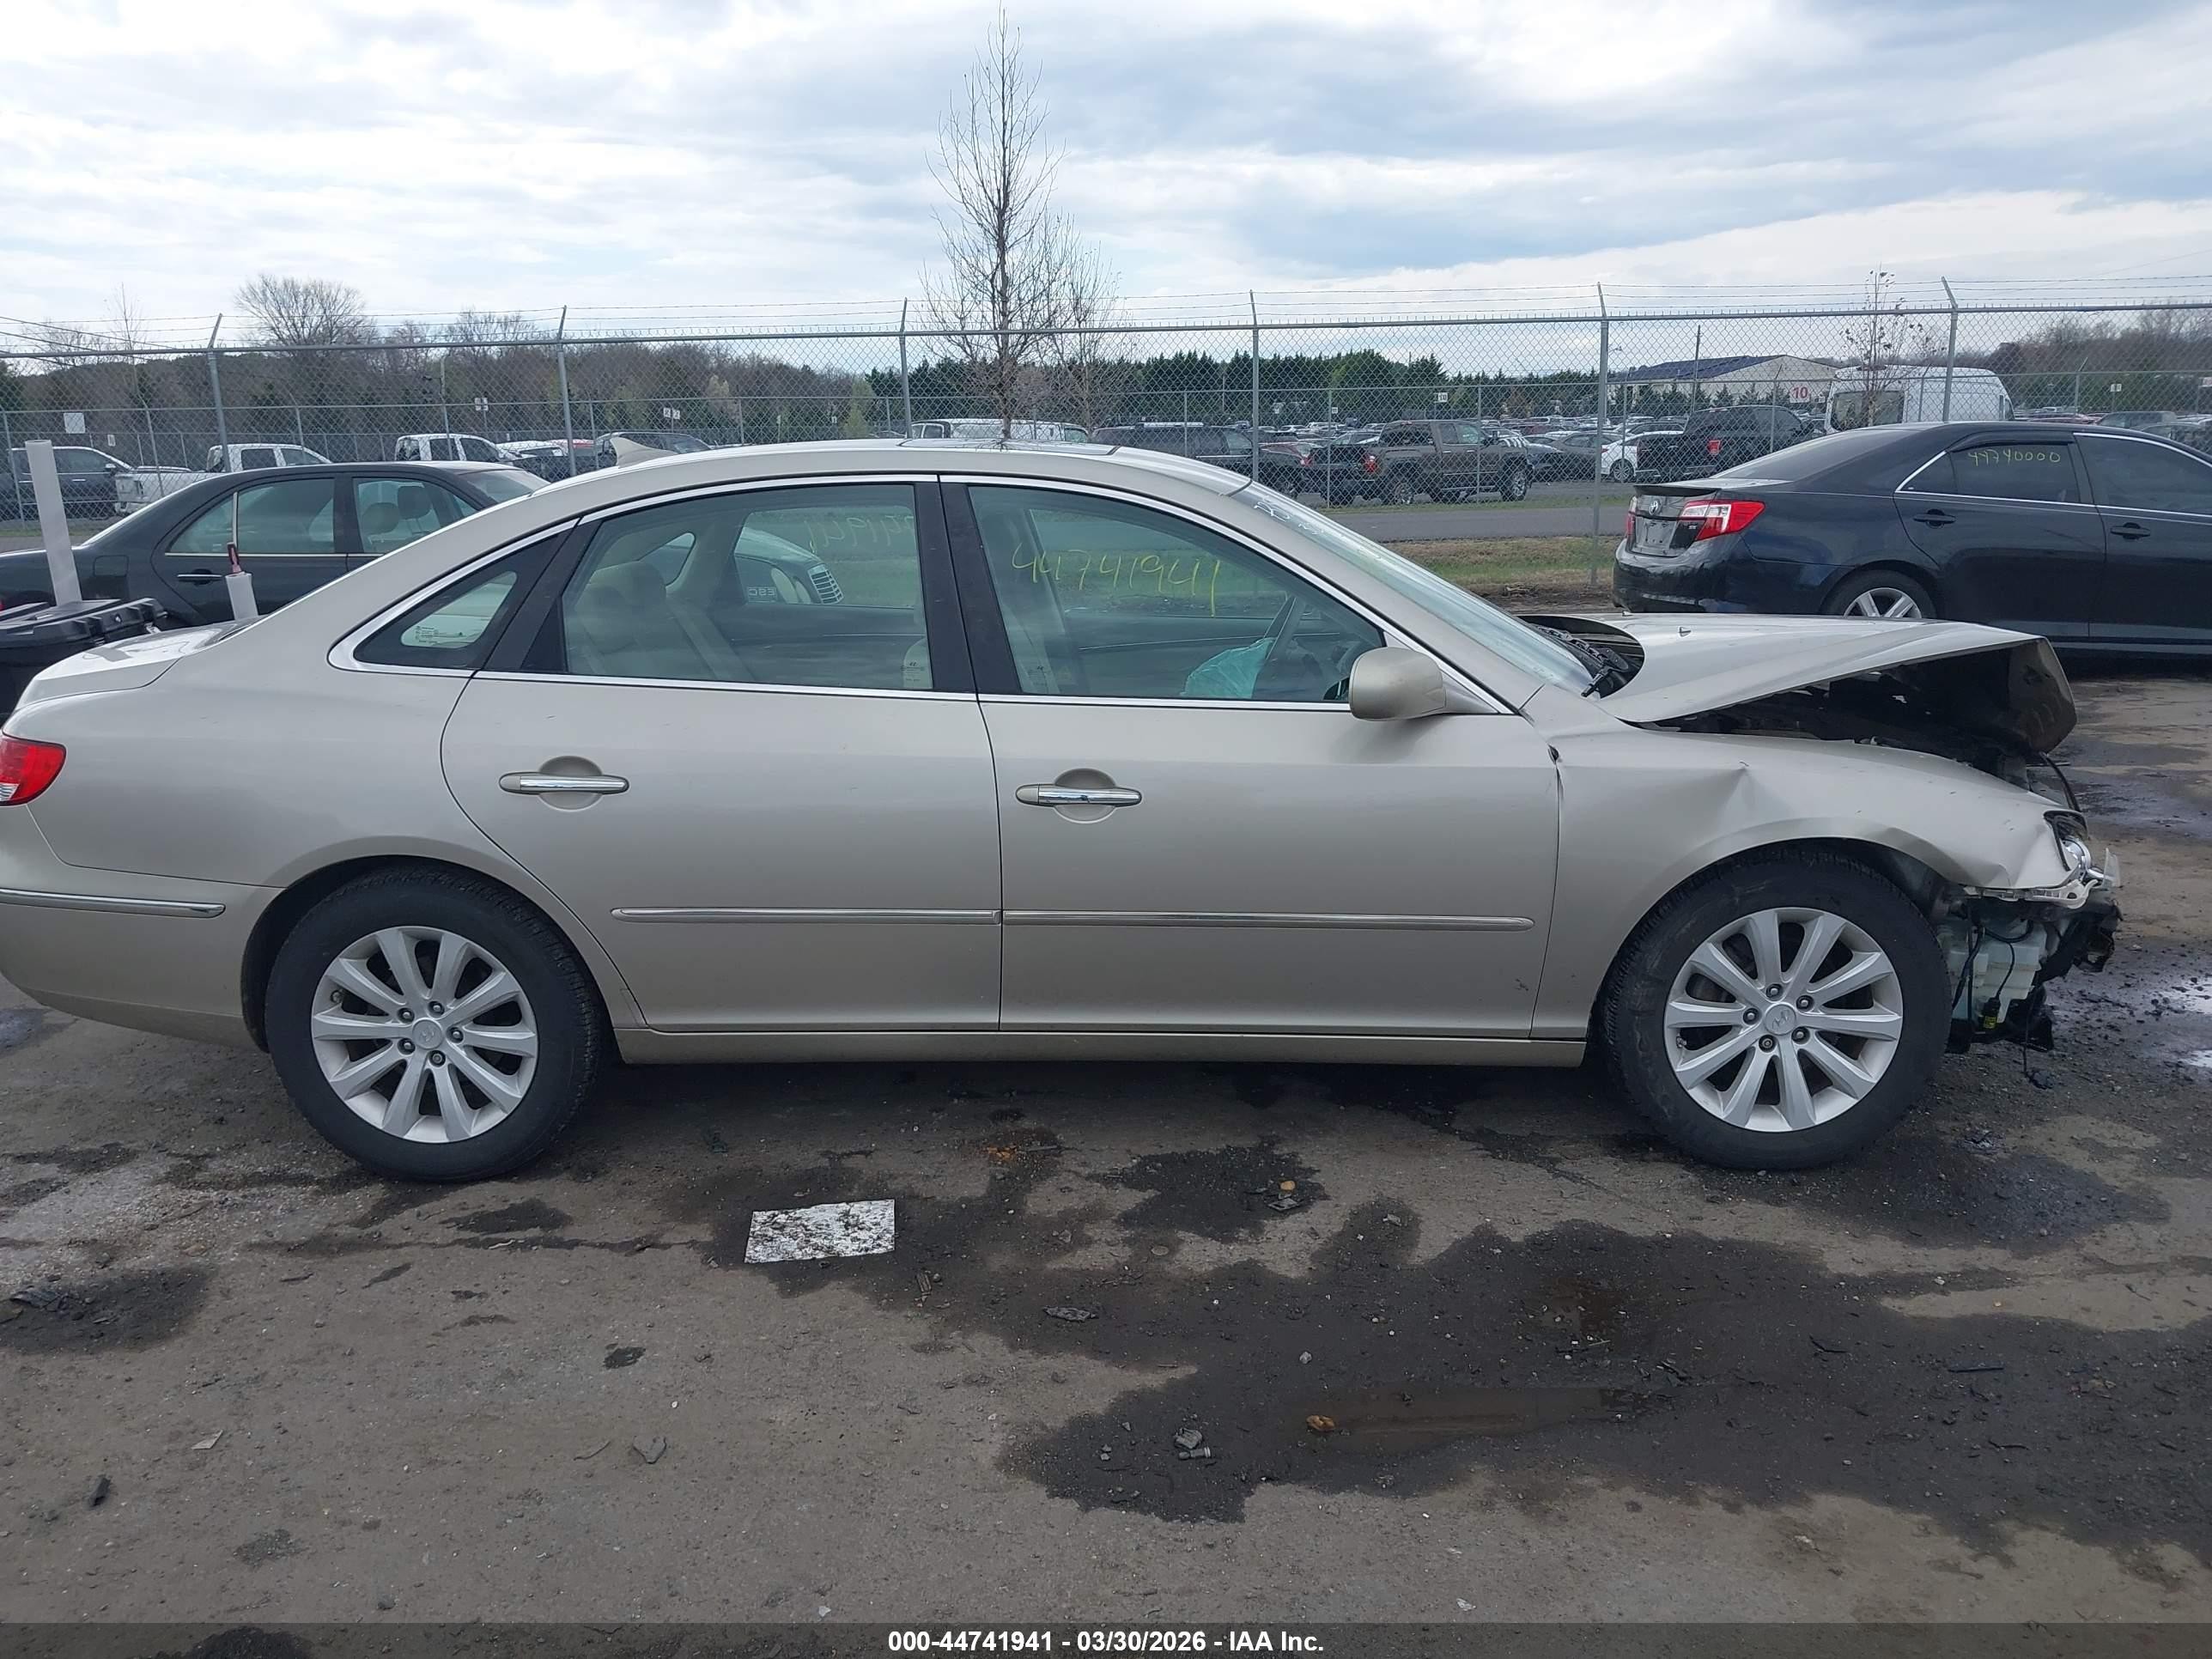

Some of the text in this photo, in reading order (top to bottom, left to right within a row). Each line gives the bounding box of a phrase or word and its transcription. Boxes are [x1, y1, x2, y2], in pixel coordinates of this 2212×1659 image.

[1793, 386, 1808, 399] 10
[1967, 448, 2061, 467] 44740000
[1012, 542, 1221, 618] 44741941
